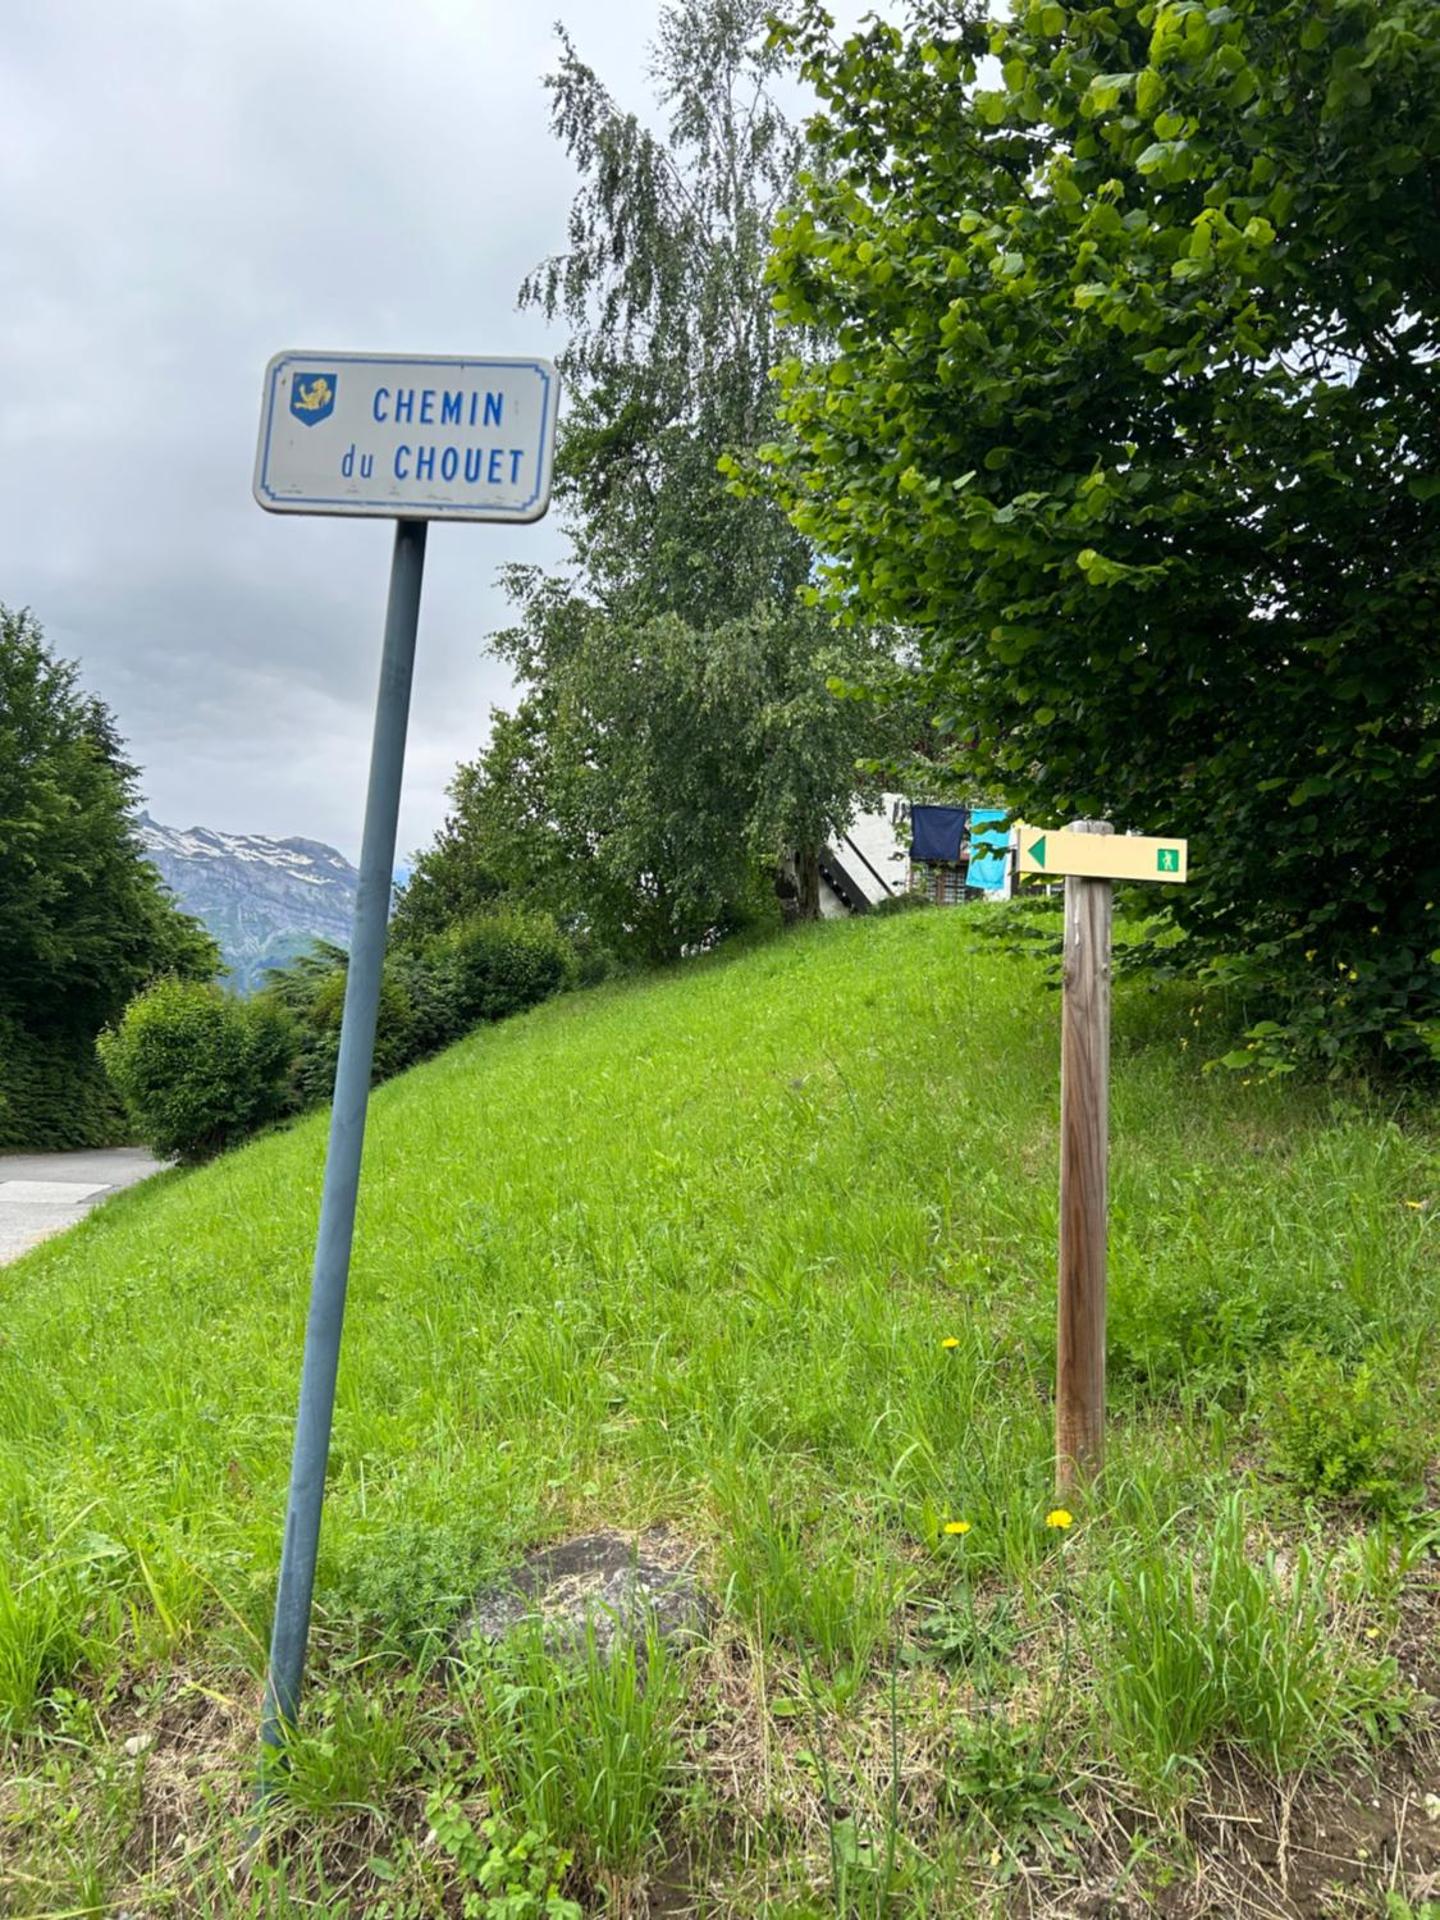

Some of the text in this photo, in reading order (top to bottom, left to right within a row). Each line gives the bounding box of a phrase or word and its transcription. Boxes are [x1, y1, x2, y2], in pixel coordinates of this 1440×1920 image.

[373, 387, 504, 426] CHEMIN
[341, 444, 524, 484] du CHOUET
